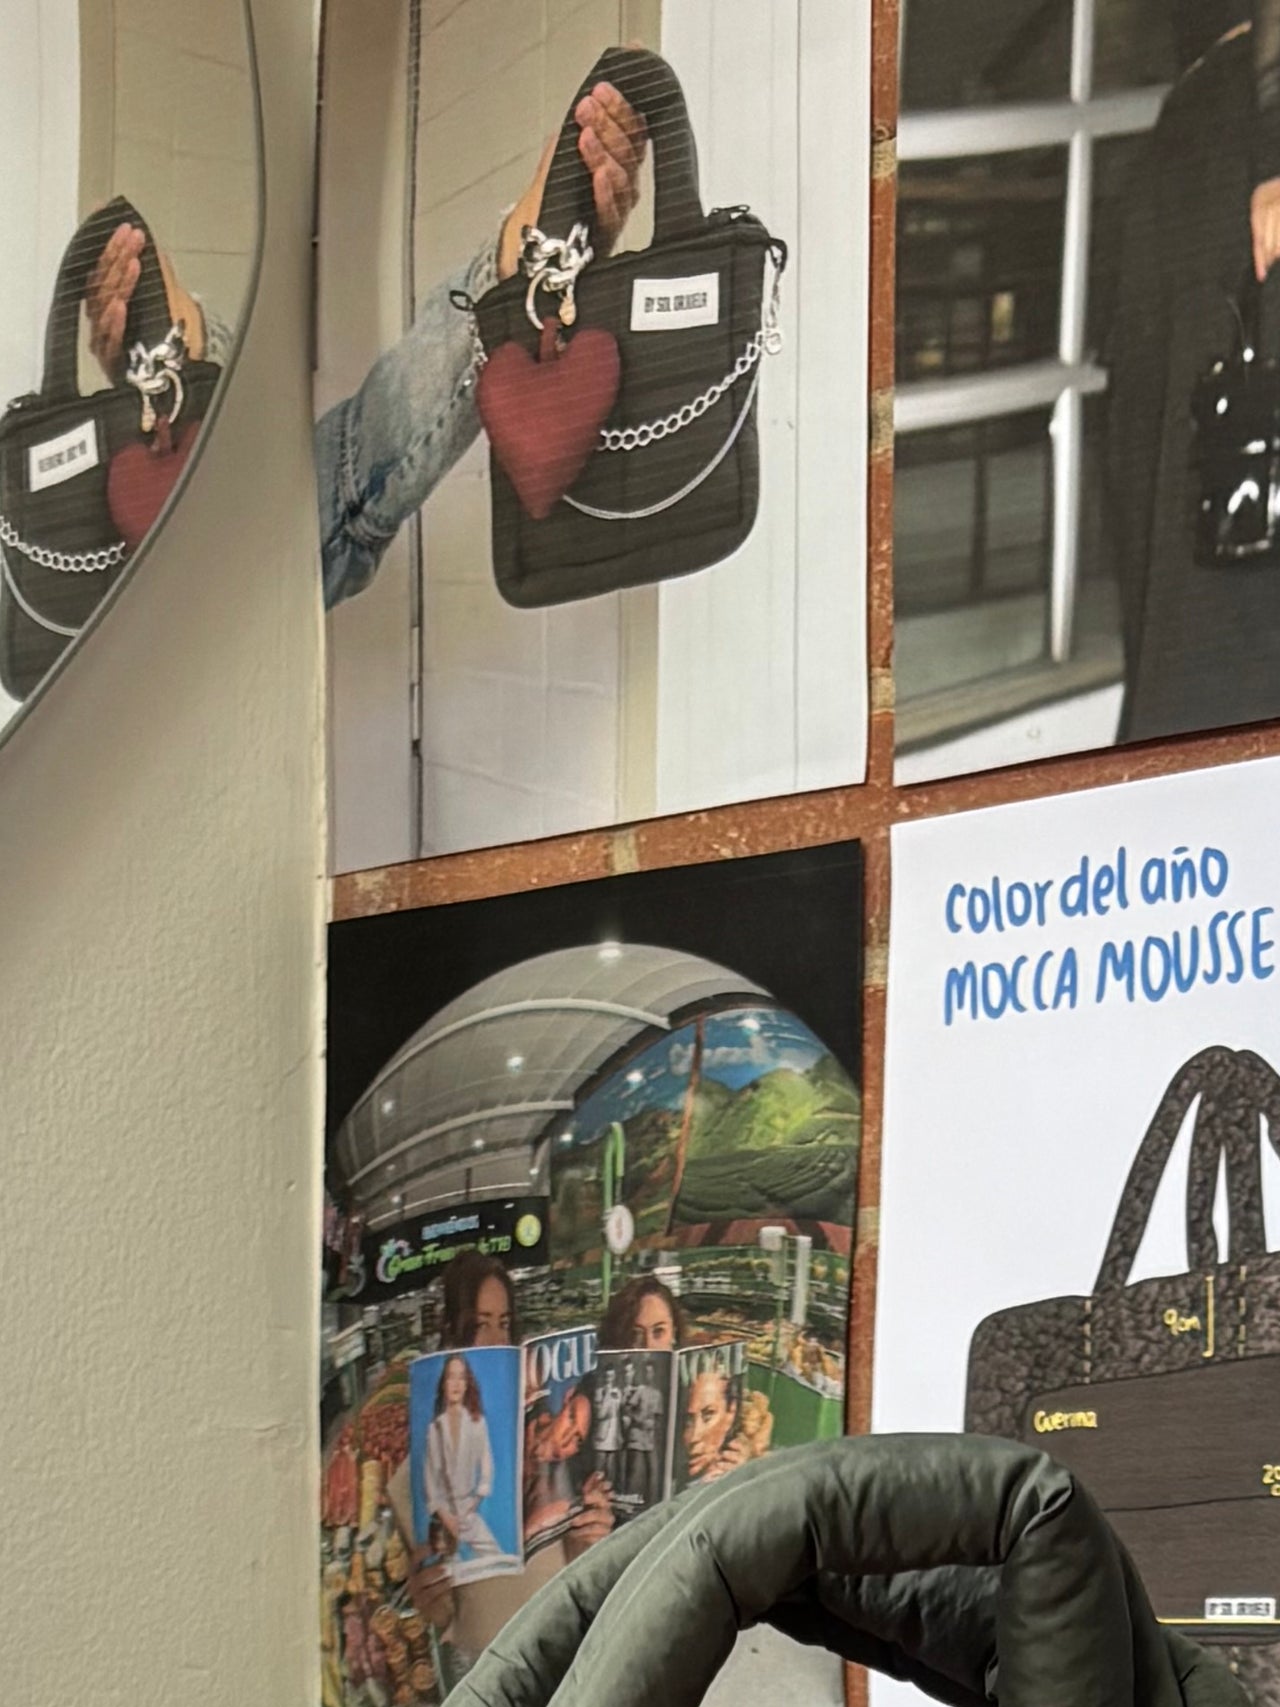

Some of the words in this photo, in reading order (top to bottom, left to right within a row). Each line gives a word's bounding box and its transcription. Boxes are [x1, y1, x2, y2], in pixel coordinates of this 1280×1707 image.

[1059, 846, 1128, 918] del
[1140, 846, 1229, 906] año
[944, 947, 1078, 1026] MOCCA
[1096, 907, 1275, 1003] MOUSSE
